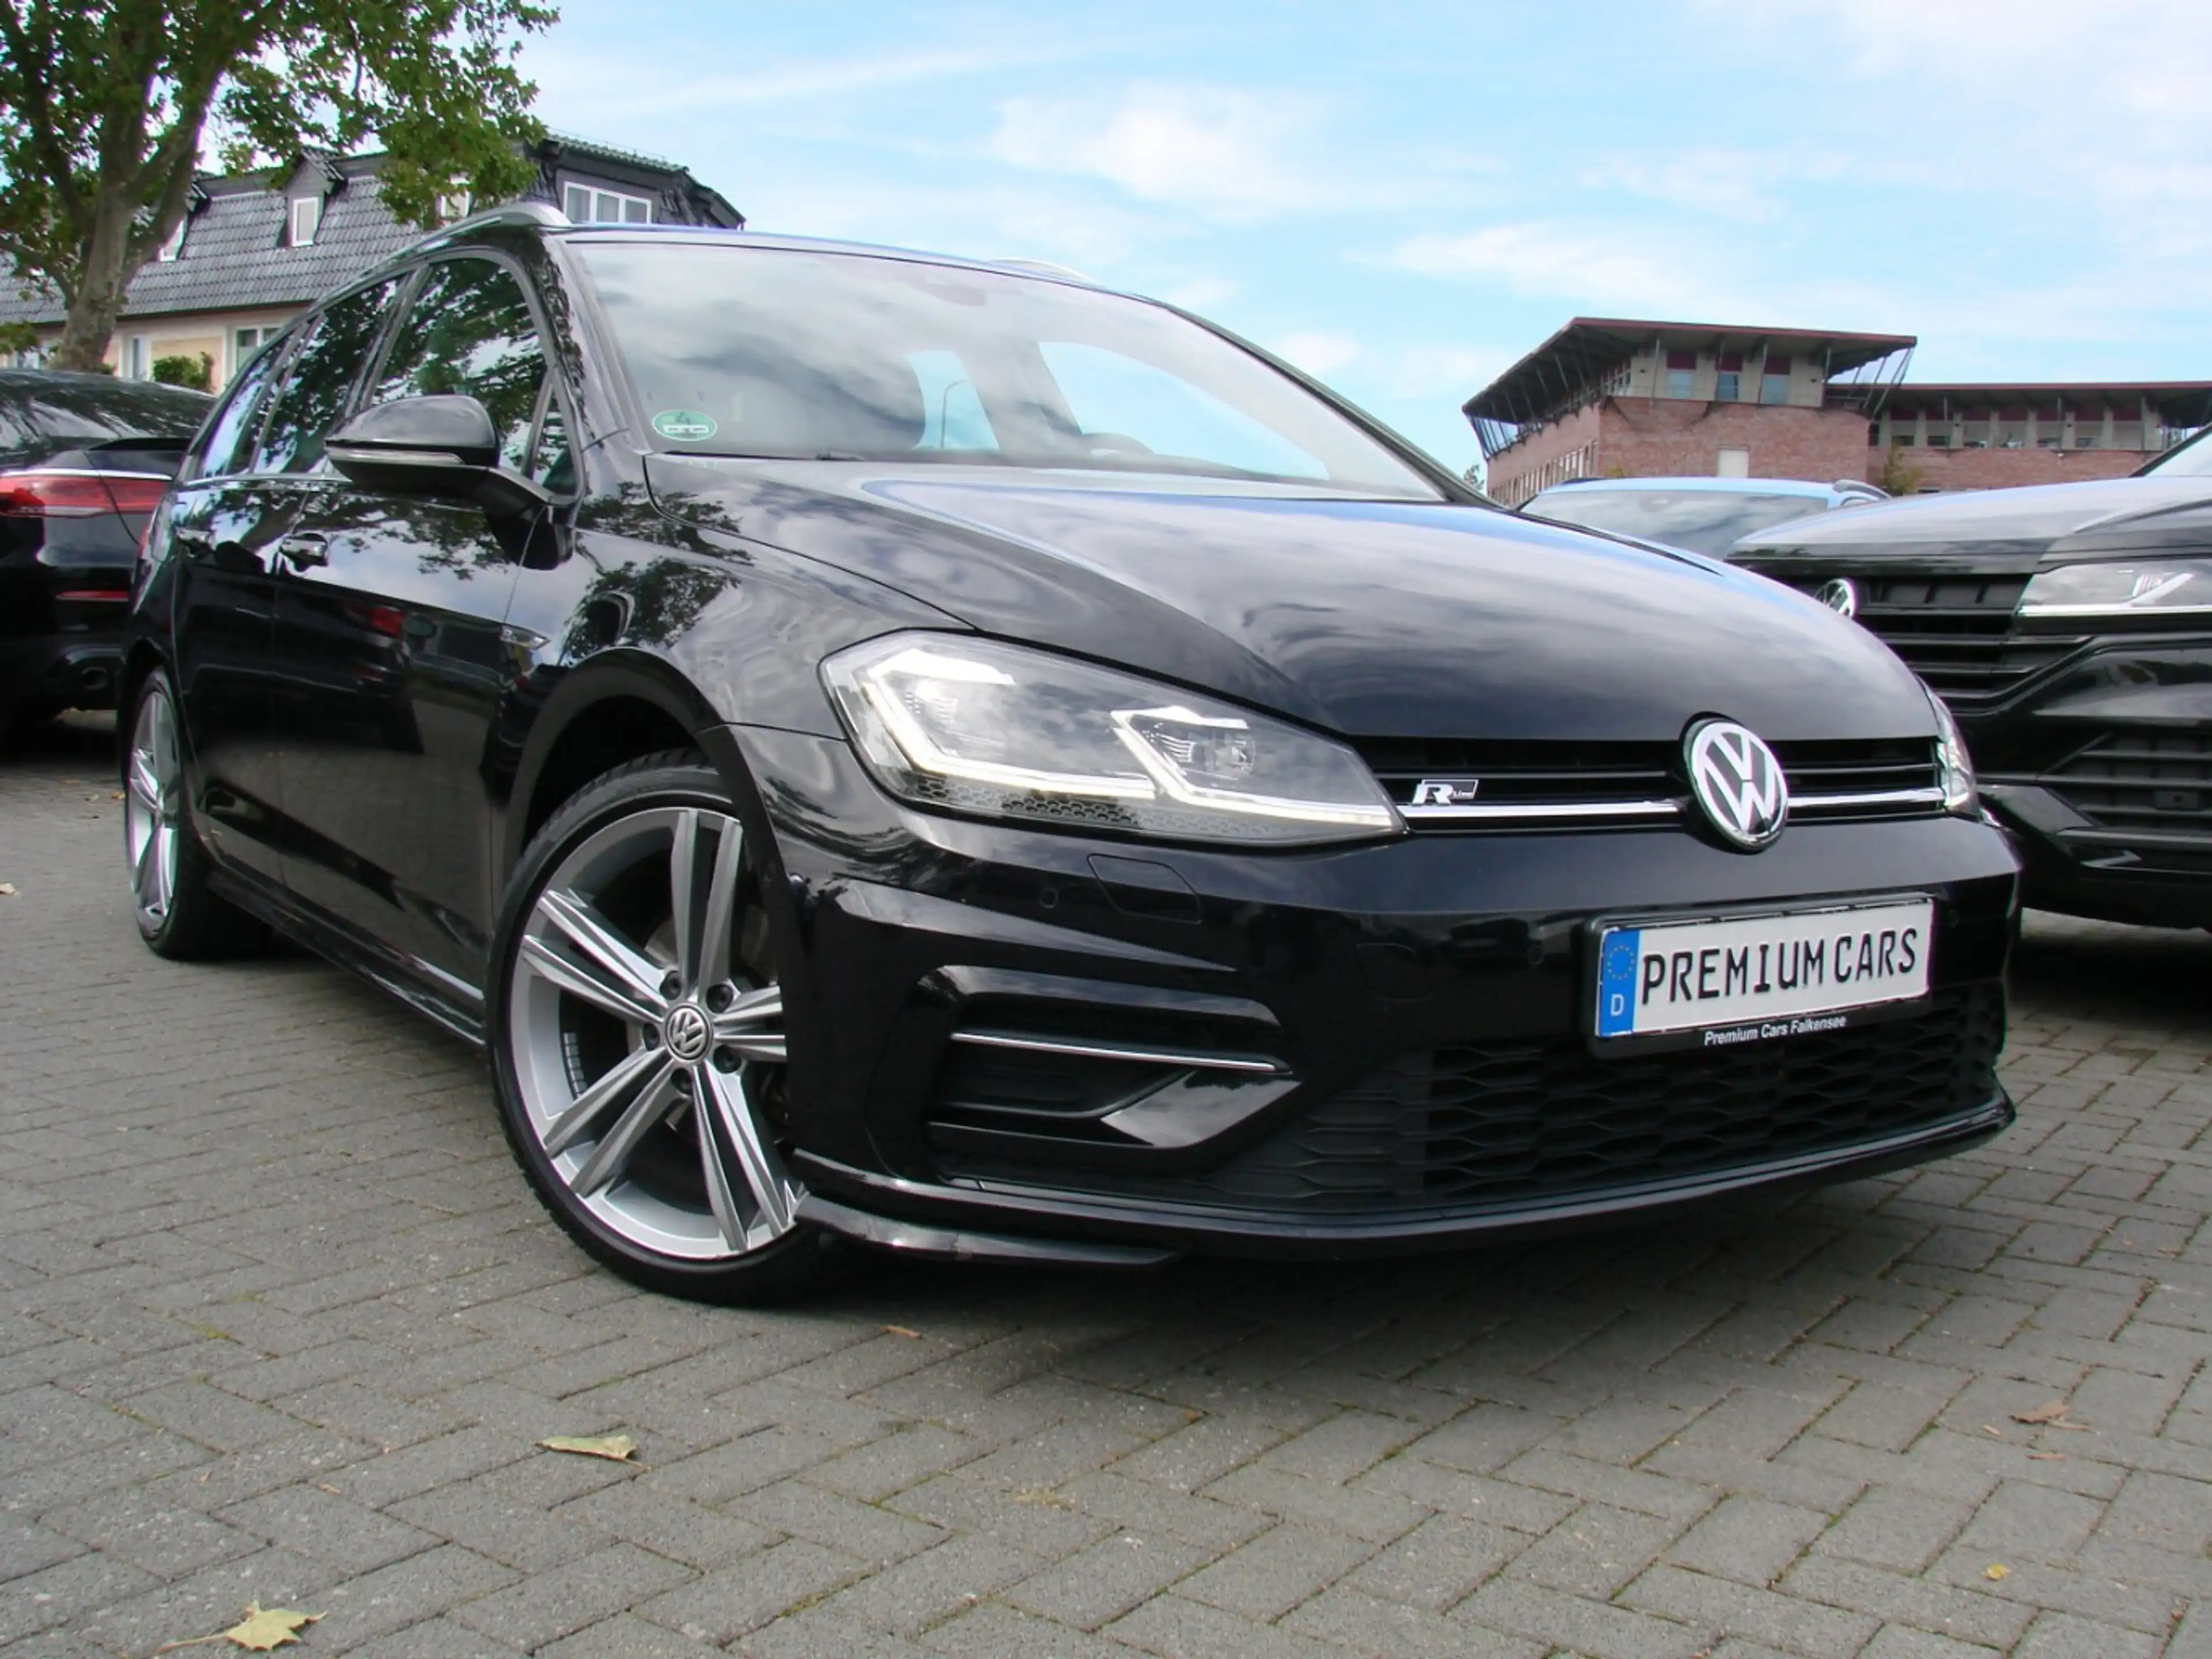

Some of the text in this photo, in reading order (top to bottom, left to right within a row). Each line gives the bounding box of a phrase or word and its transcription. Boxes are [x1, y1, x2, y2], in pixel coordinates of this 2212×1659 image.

[1642, 928, 1917, 1005] PREMIUM CARS
[1610, 994, 1624, 1016] D
[1704, 1016, 1847, 1046] Premium Cars Falkensee
